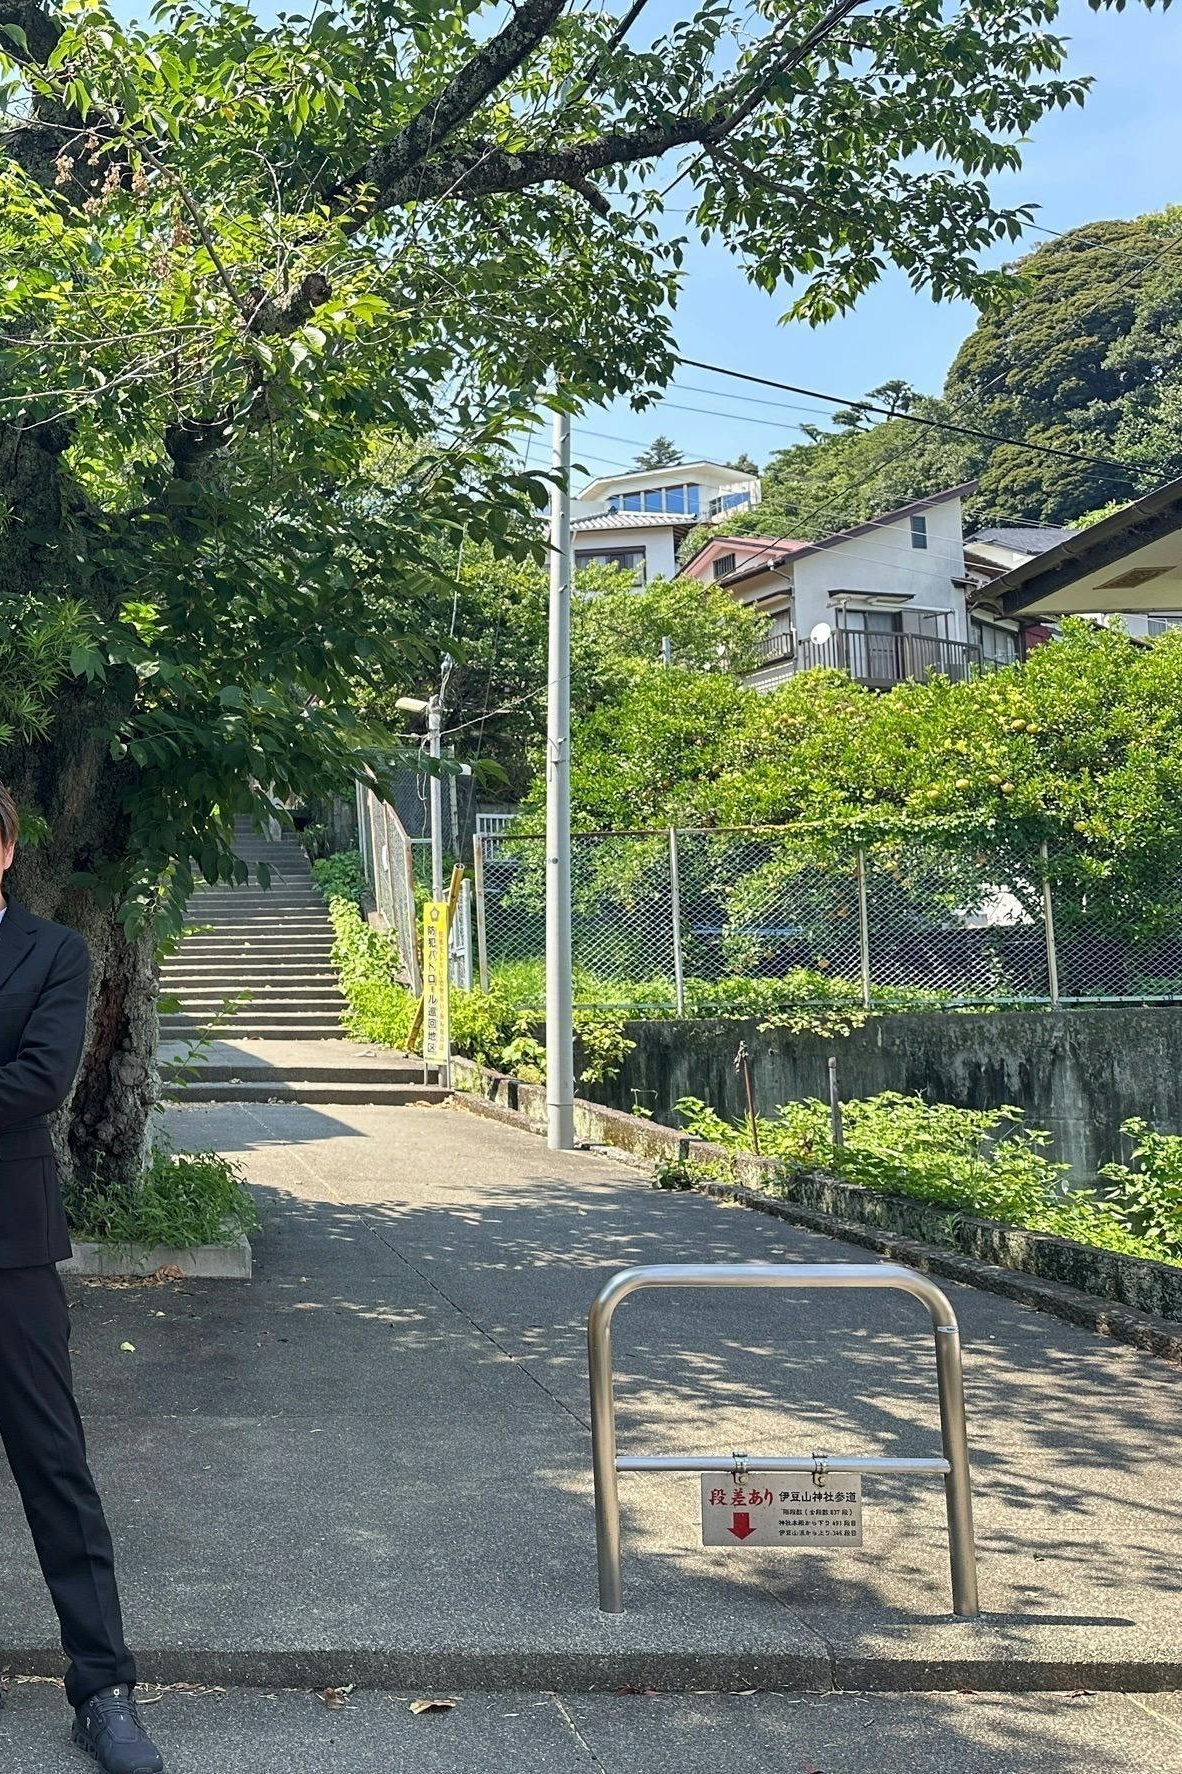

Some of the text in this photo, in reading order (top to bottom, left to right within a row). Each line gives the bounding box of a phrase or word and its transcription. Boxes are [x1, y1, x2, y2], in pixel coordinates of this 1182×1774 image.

[708, 1487, 773, 1506] 段差あり
[778, 1491, 857, 1503] 伊豆山神社参道
